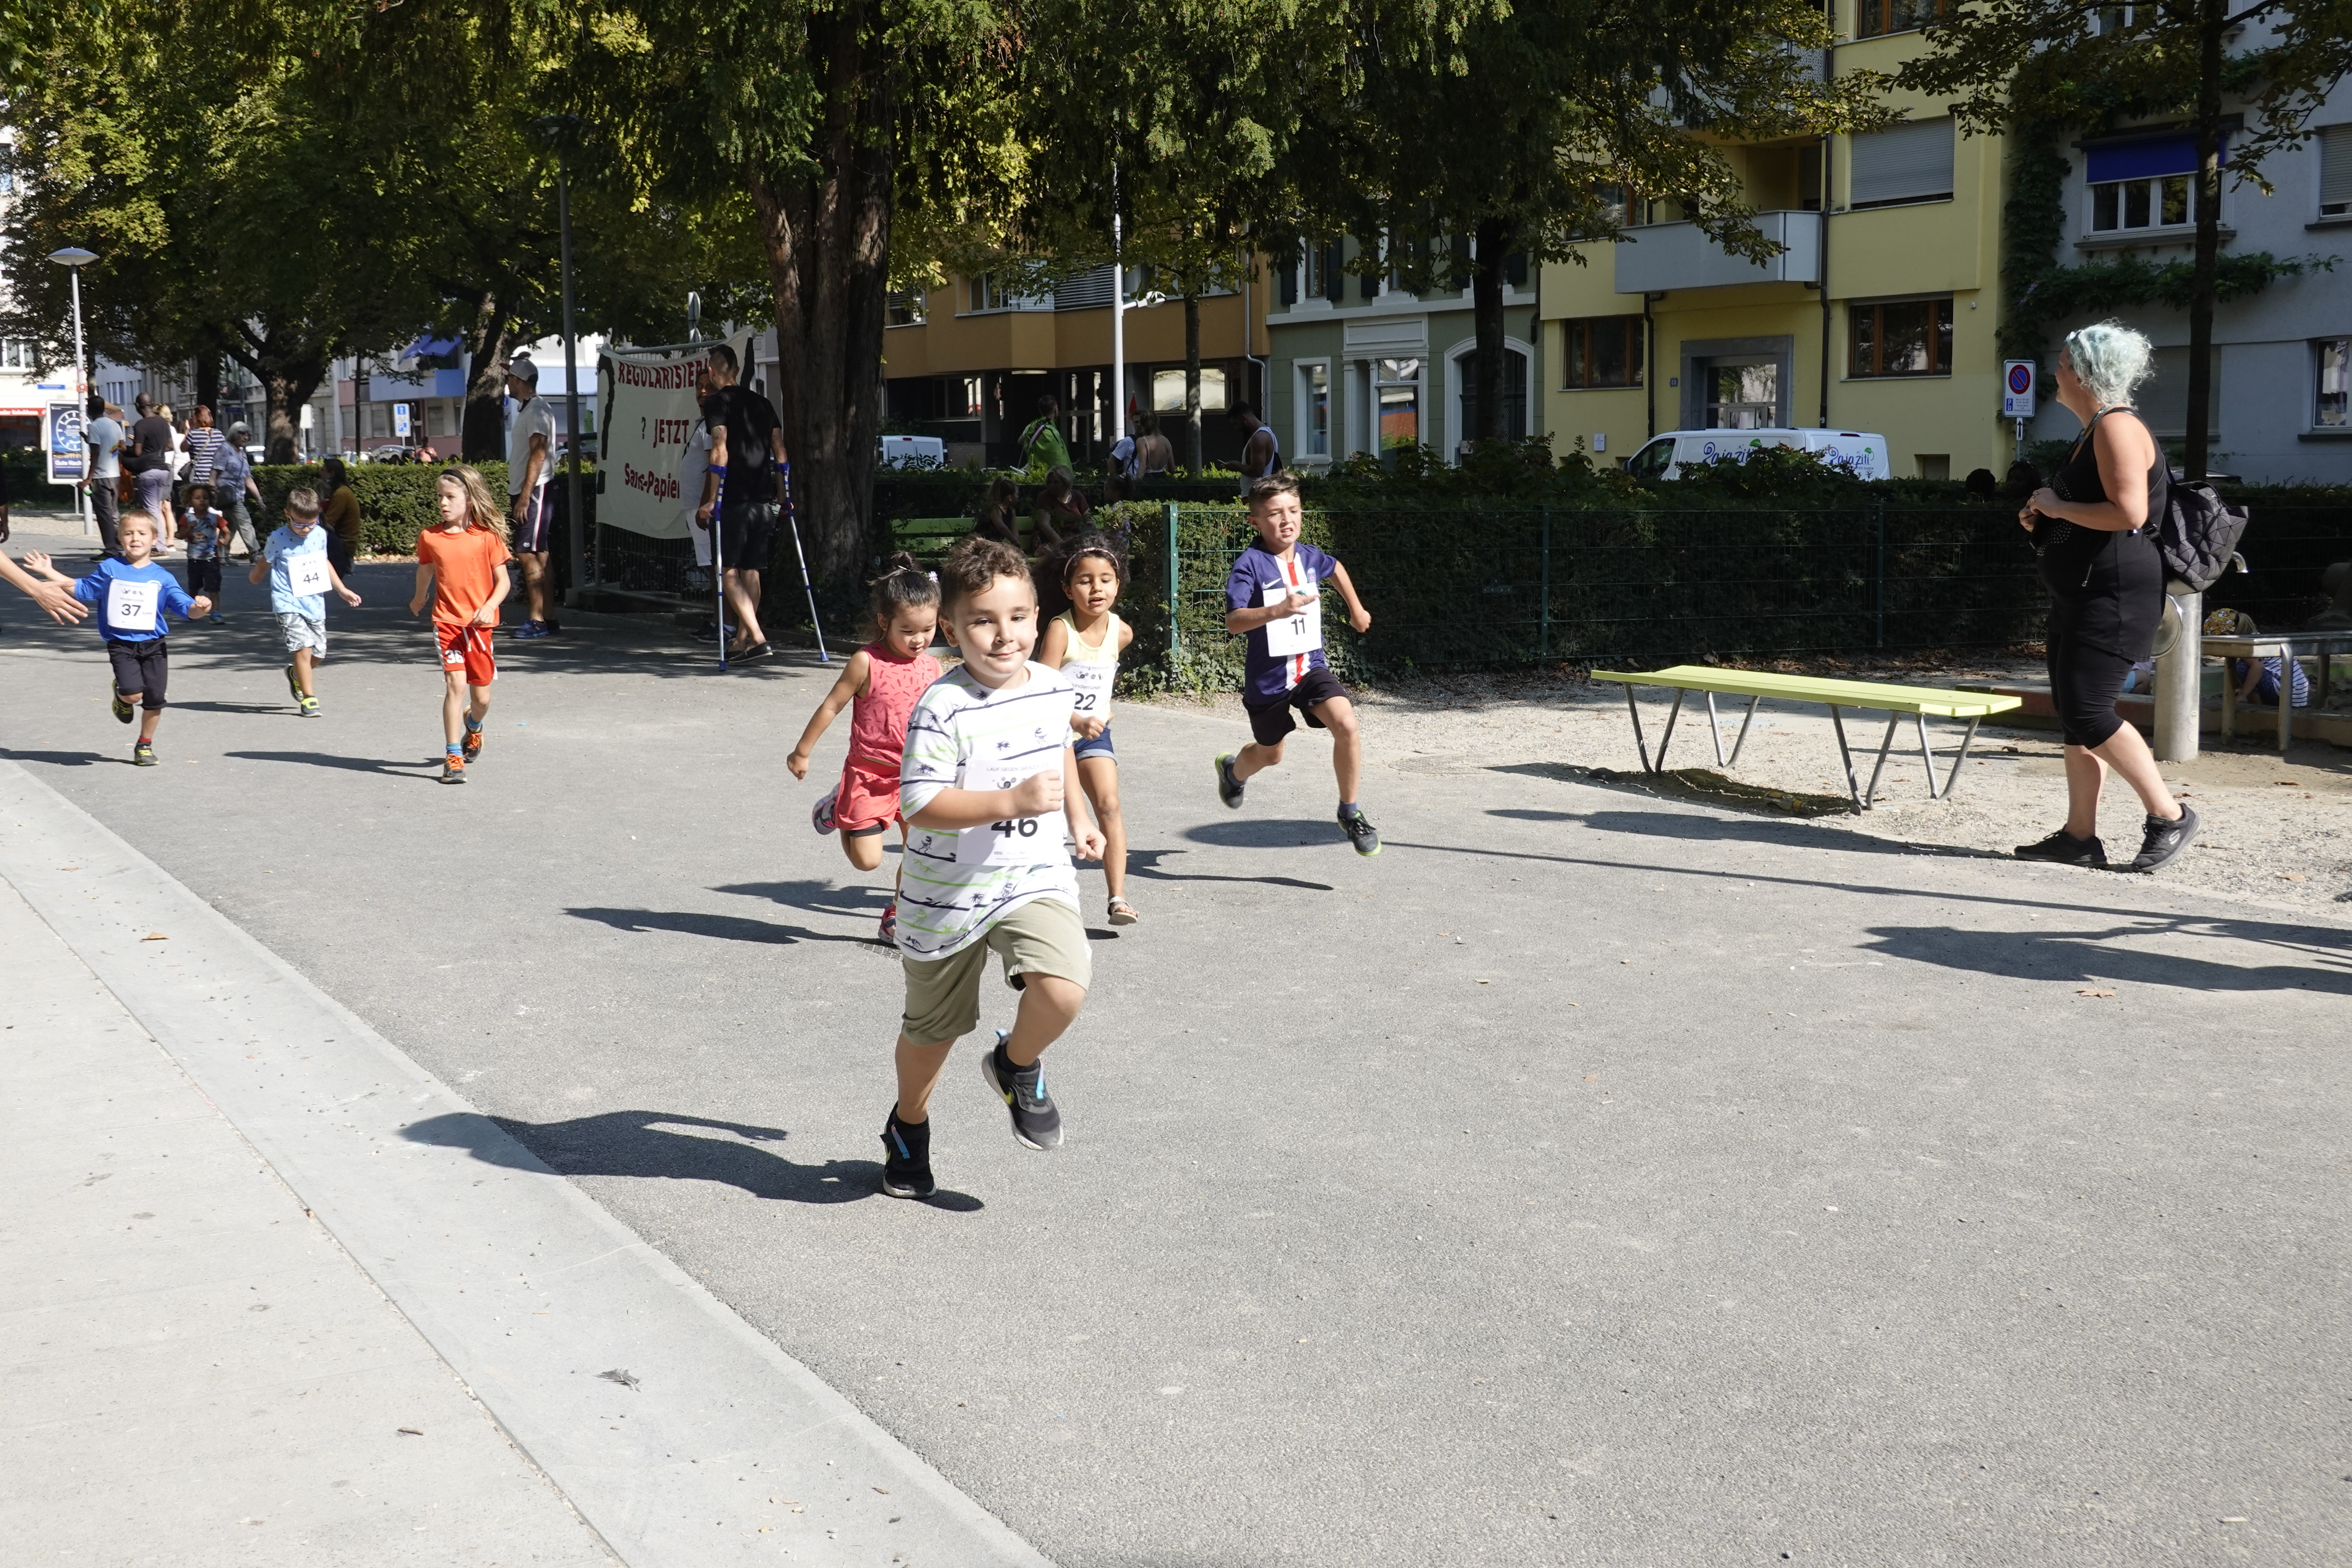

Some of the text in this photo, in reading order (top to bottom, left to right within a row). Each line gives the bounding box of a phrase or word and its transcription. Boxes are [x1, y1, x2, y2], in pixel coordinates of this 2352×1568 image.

[618, 358, 708, 389] REGULARISIER
[653, 419, 689, 448] JETZT
[303, 572, 319, 583] 44
[121, 604, 141, 616] 37
[1291, 617, 1305, 635] 11
[445, 650, 464, 664] 36
[1074, 692, 1096, 710] 22
[991, 816, 1039, 838] 46
